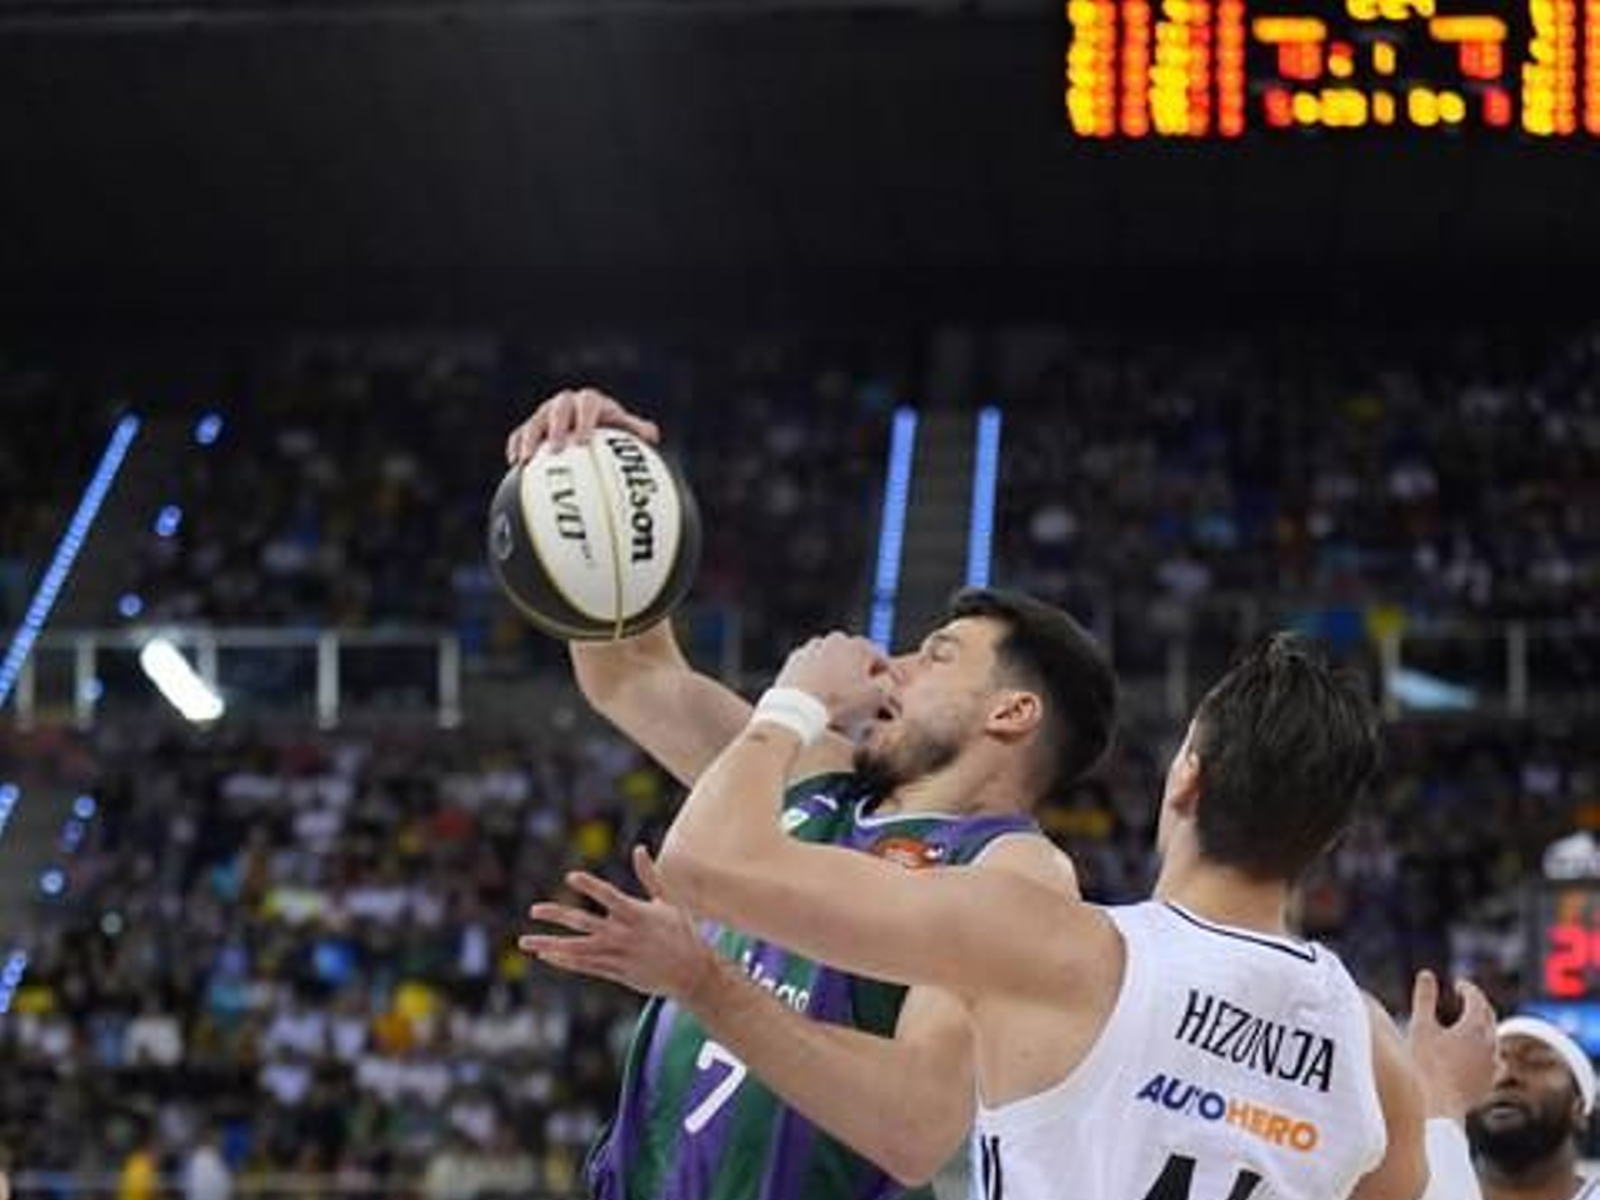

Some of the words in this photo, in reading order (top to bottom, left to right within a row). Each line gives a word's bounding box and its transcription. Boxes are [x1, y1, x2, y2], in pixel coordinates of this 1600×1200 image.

[684, 1039, 747, 1133] 7
[1175, 988, 1335, 1093] HEZONJA
[1137, 1073, 1318, 1152] AUTOHERO
